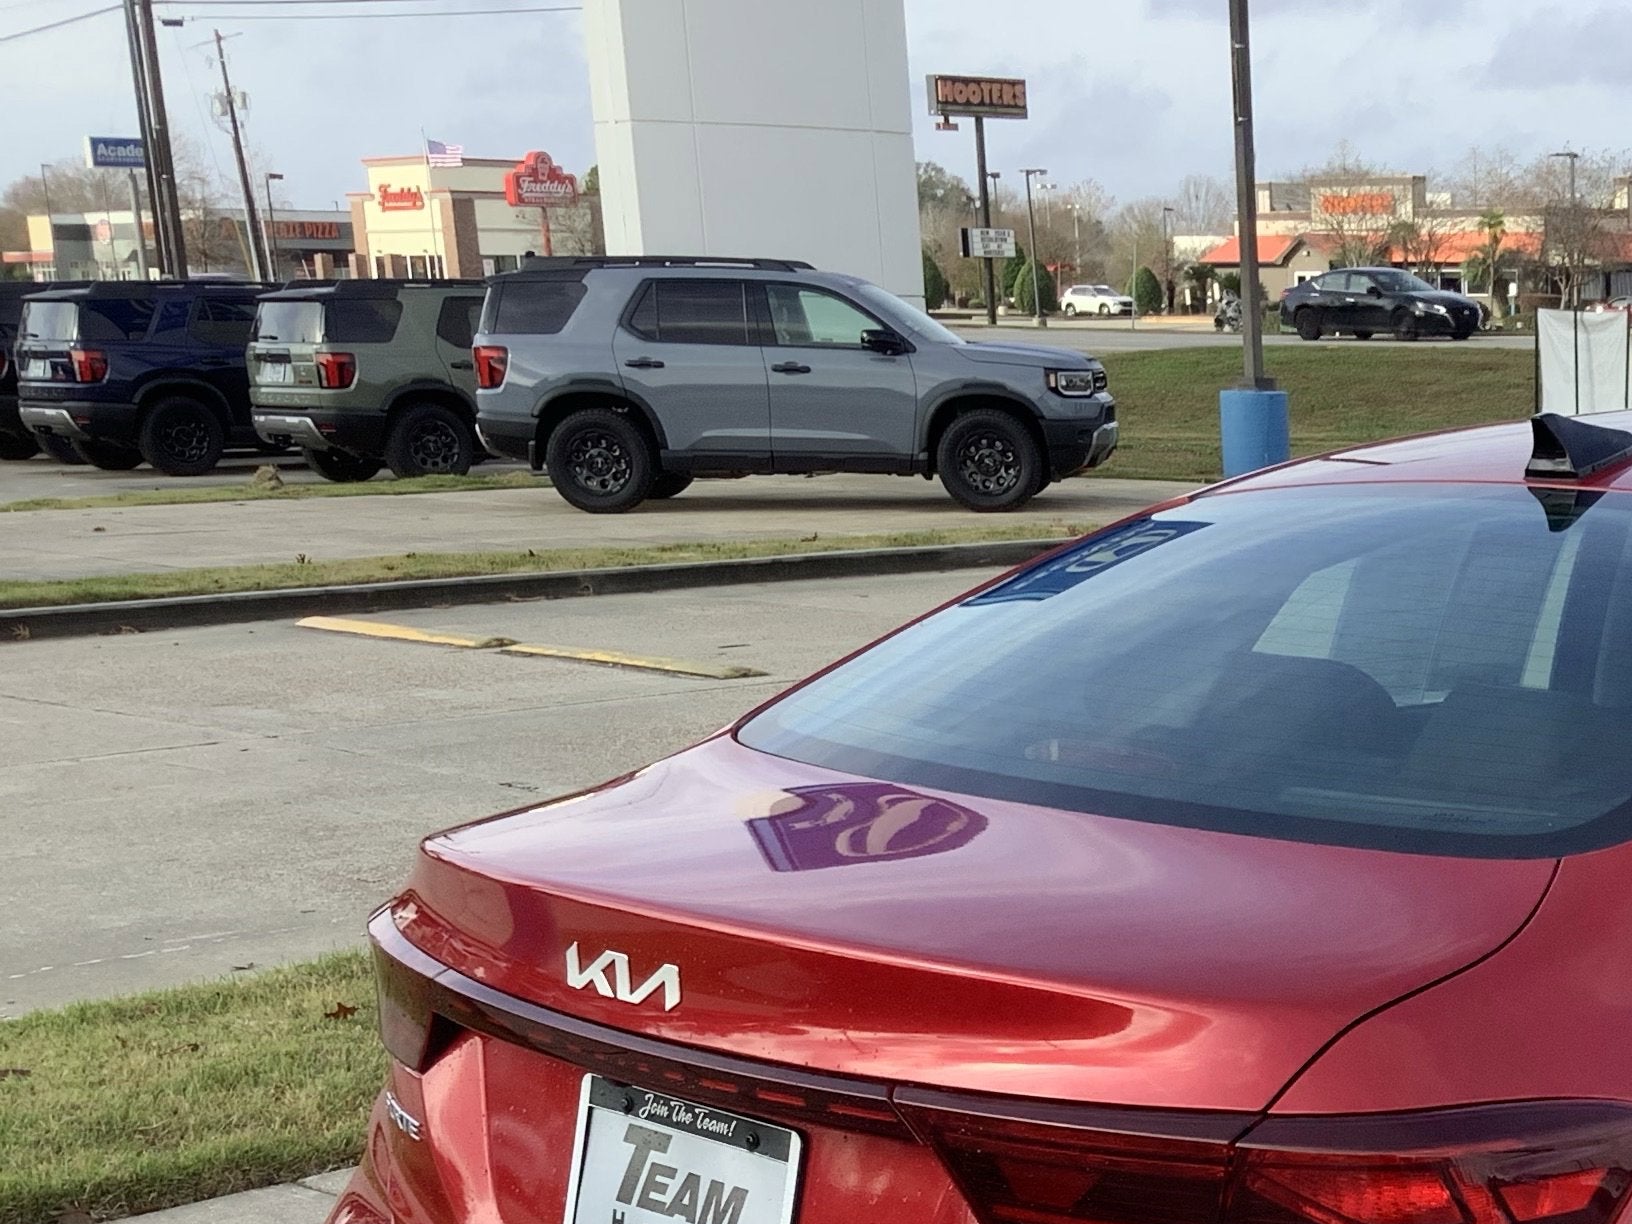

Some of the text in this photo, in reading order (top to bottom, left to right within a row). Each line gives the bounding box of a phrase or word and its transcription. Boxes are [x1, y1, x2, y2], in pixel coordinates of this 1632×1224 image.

[938, 80, 1024, 106] HOOTERS
[518, 177, 574, 197] Freddy's
[303, 221, 340, 239] PIZZA
[565, 941, 681, 1012] KIA
[638, 1094, 738, 1137] Join The Team!
